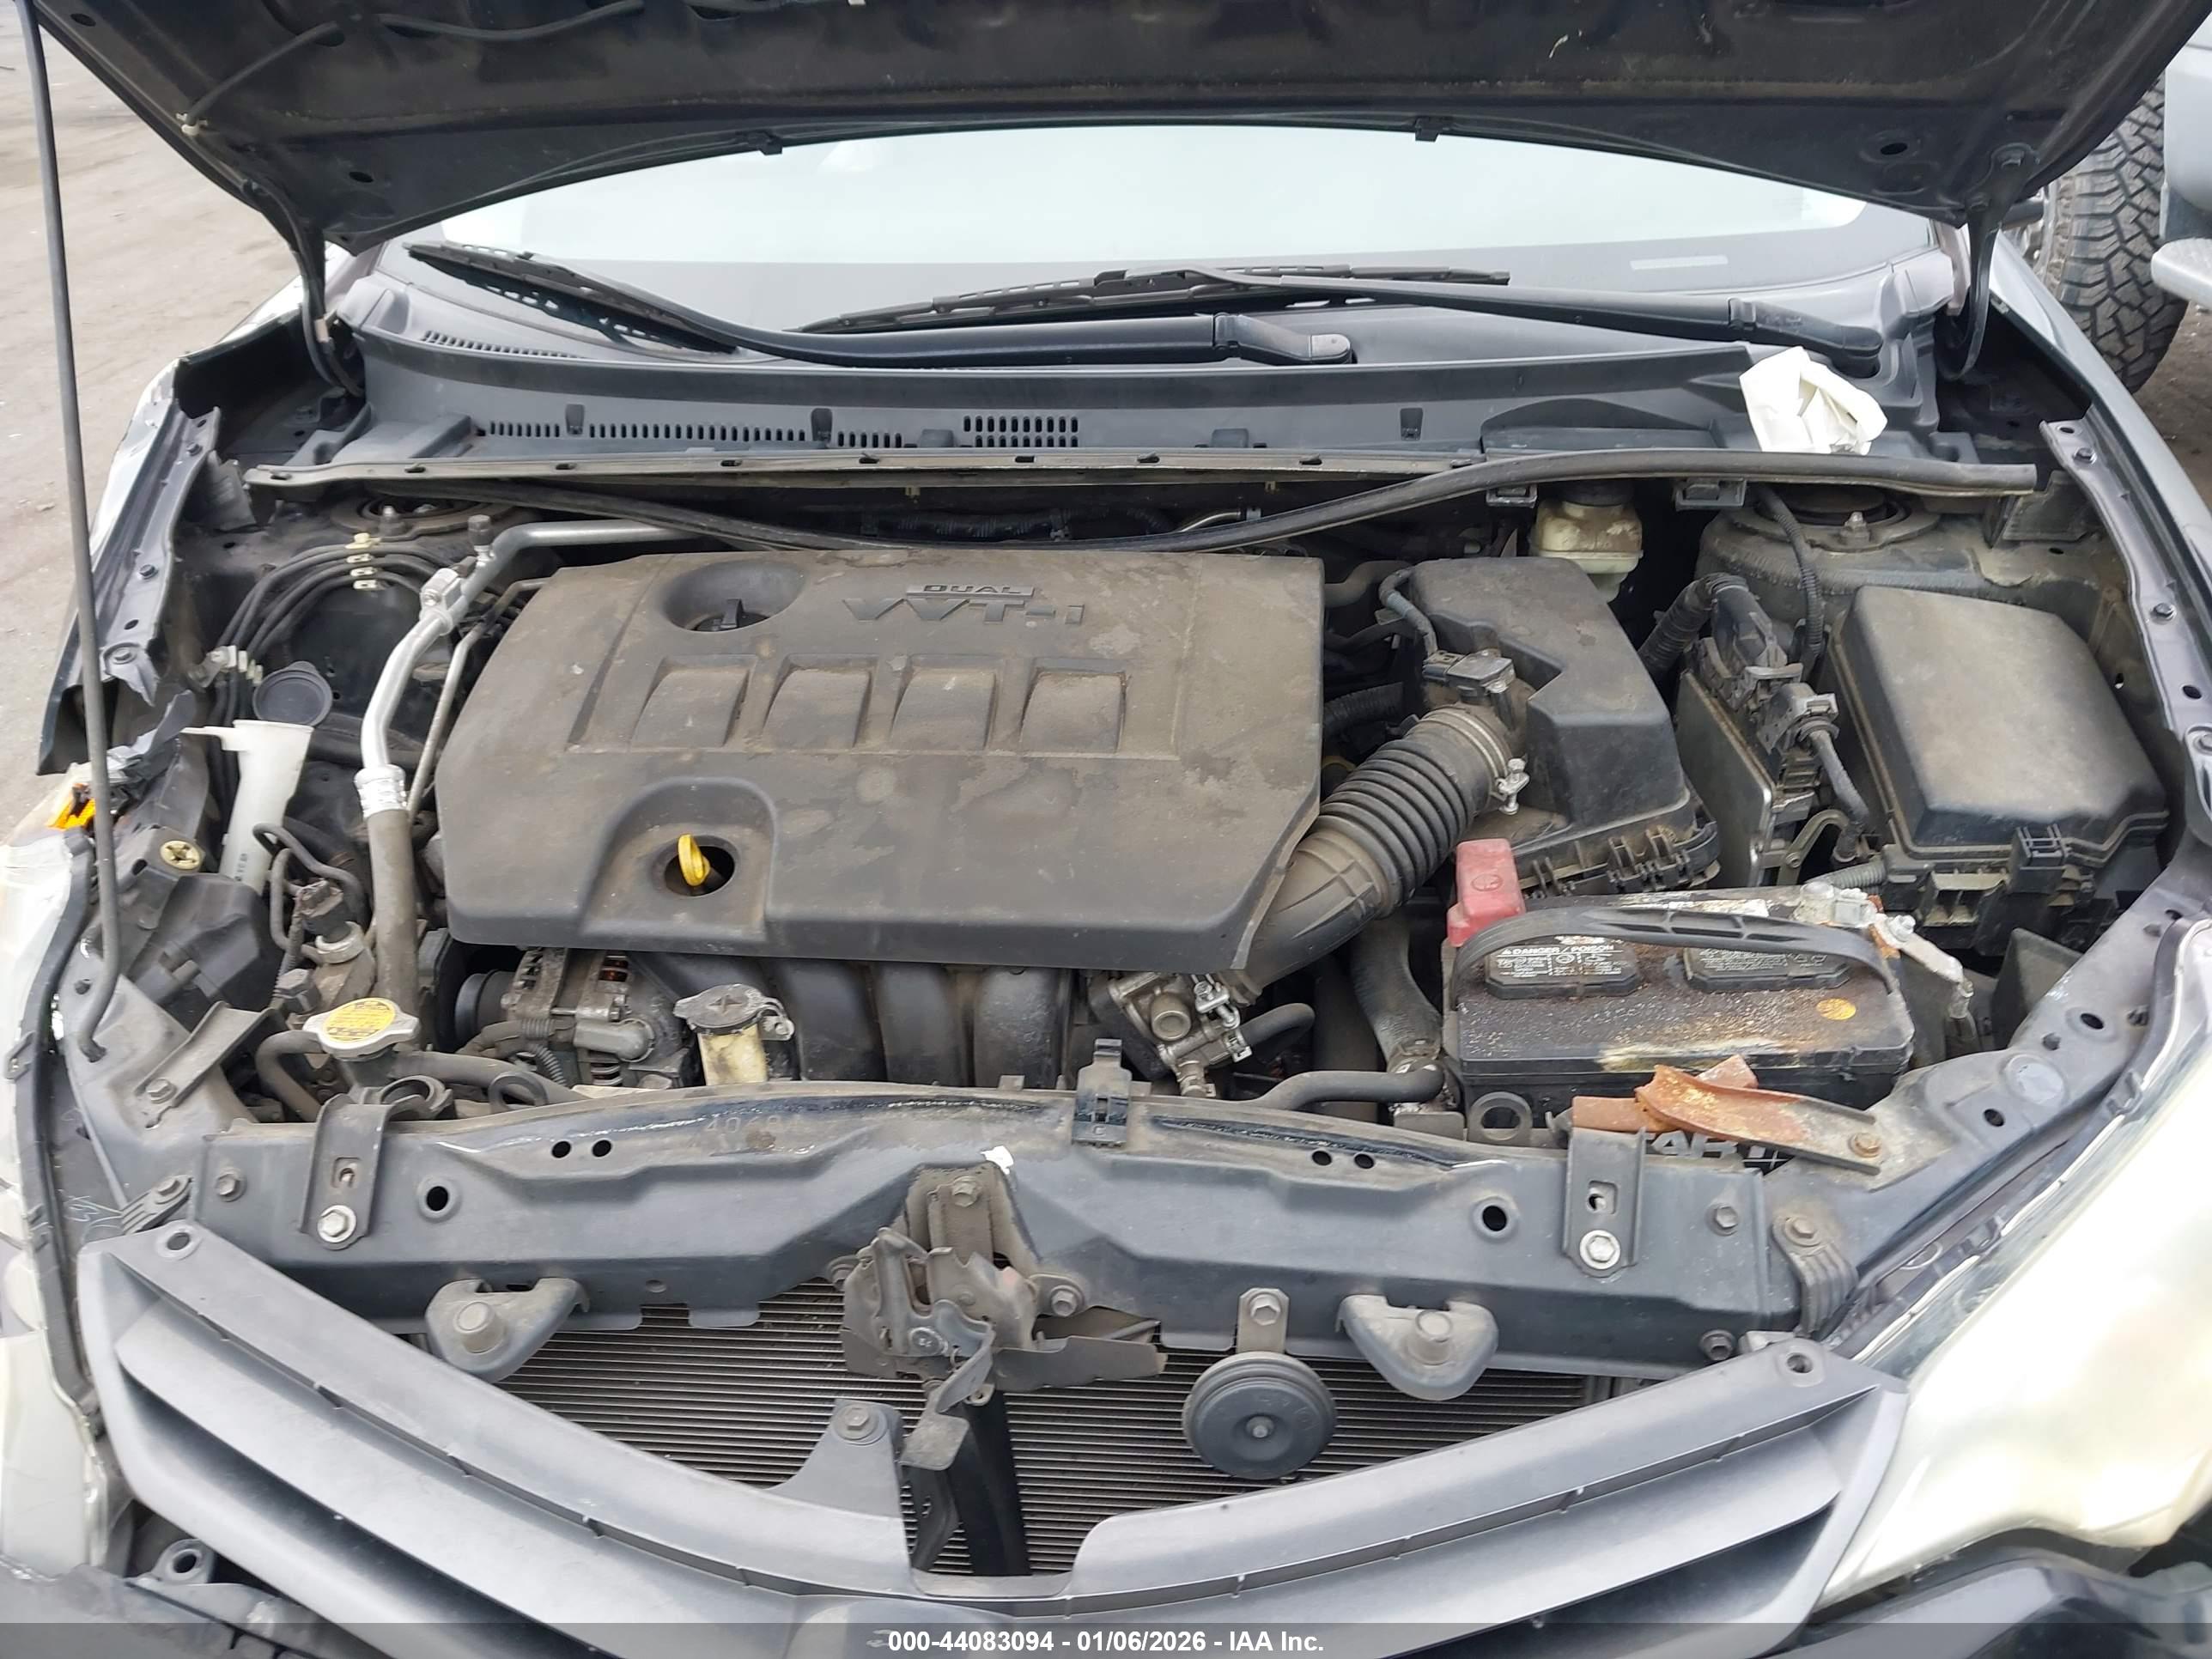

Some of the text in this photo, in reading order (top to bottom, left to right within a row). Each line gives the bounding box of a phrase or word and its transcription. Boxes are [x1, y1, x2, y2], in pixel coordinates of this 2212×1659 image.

[921, 584, 1024, 595] DUAL
[1511, 946, 1560, 955] DANGER
[1571, 945, 1615, 953] POISON
